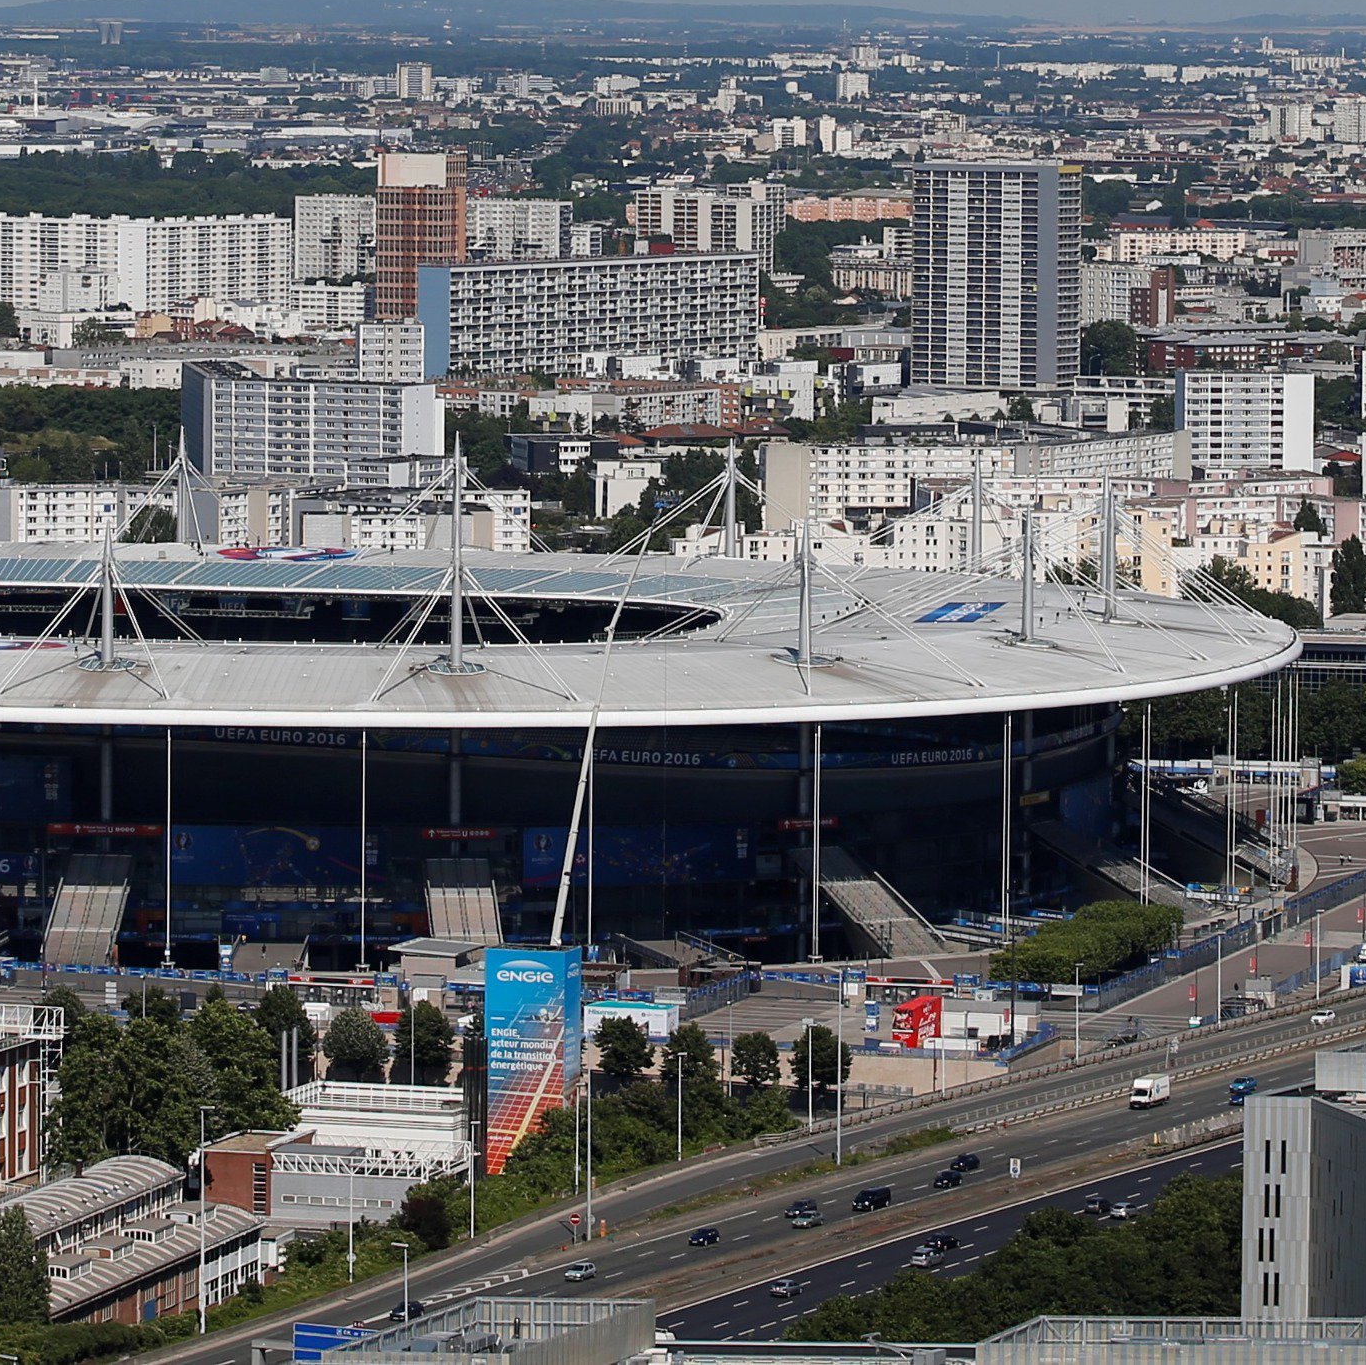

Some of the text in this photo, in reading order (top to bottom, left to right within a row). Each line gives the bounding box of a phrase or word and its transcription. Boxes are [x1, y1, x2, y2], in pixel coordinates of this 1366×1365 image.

[215, 727, 346, 745] UEFA EURO 2016
[621, 750, 661, 764] EURO
[664, 753, 701, 765] 2016
[891, 748, 972, 764] UEFA EURO 2016
[490, 1027, 521, 1039] ENGIE,
[490, 1039, 557, 1049] acteur mondial
[490, 1049, 557, 1061] de la transition
[490, 1060, 545, 1072] énergétique
